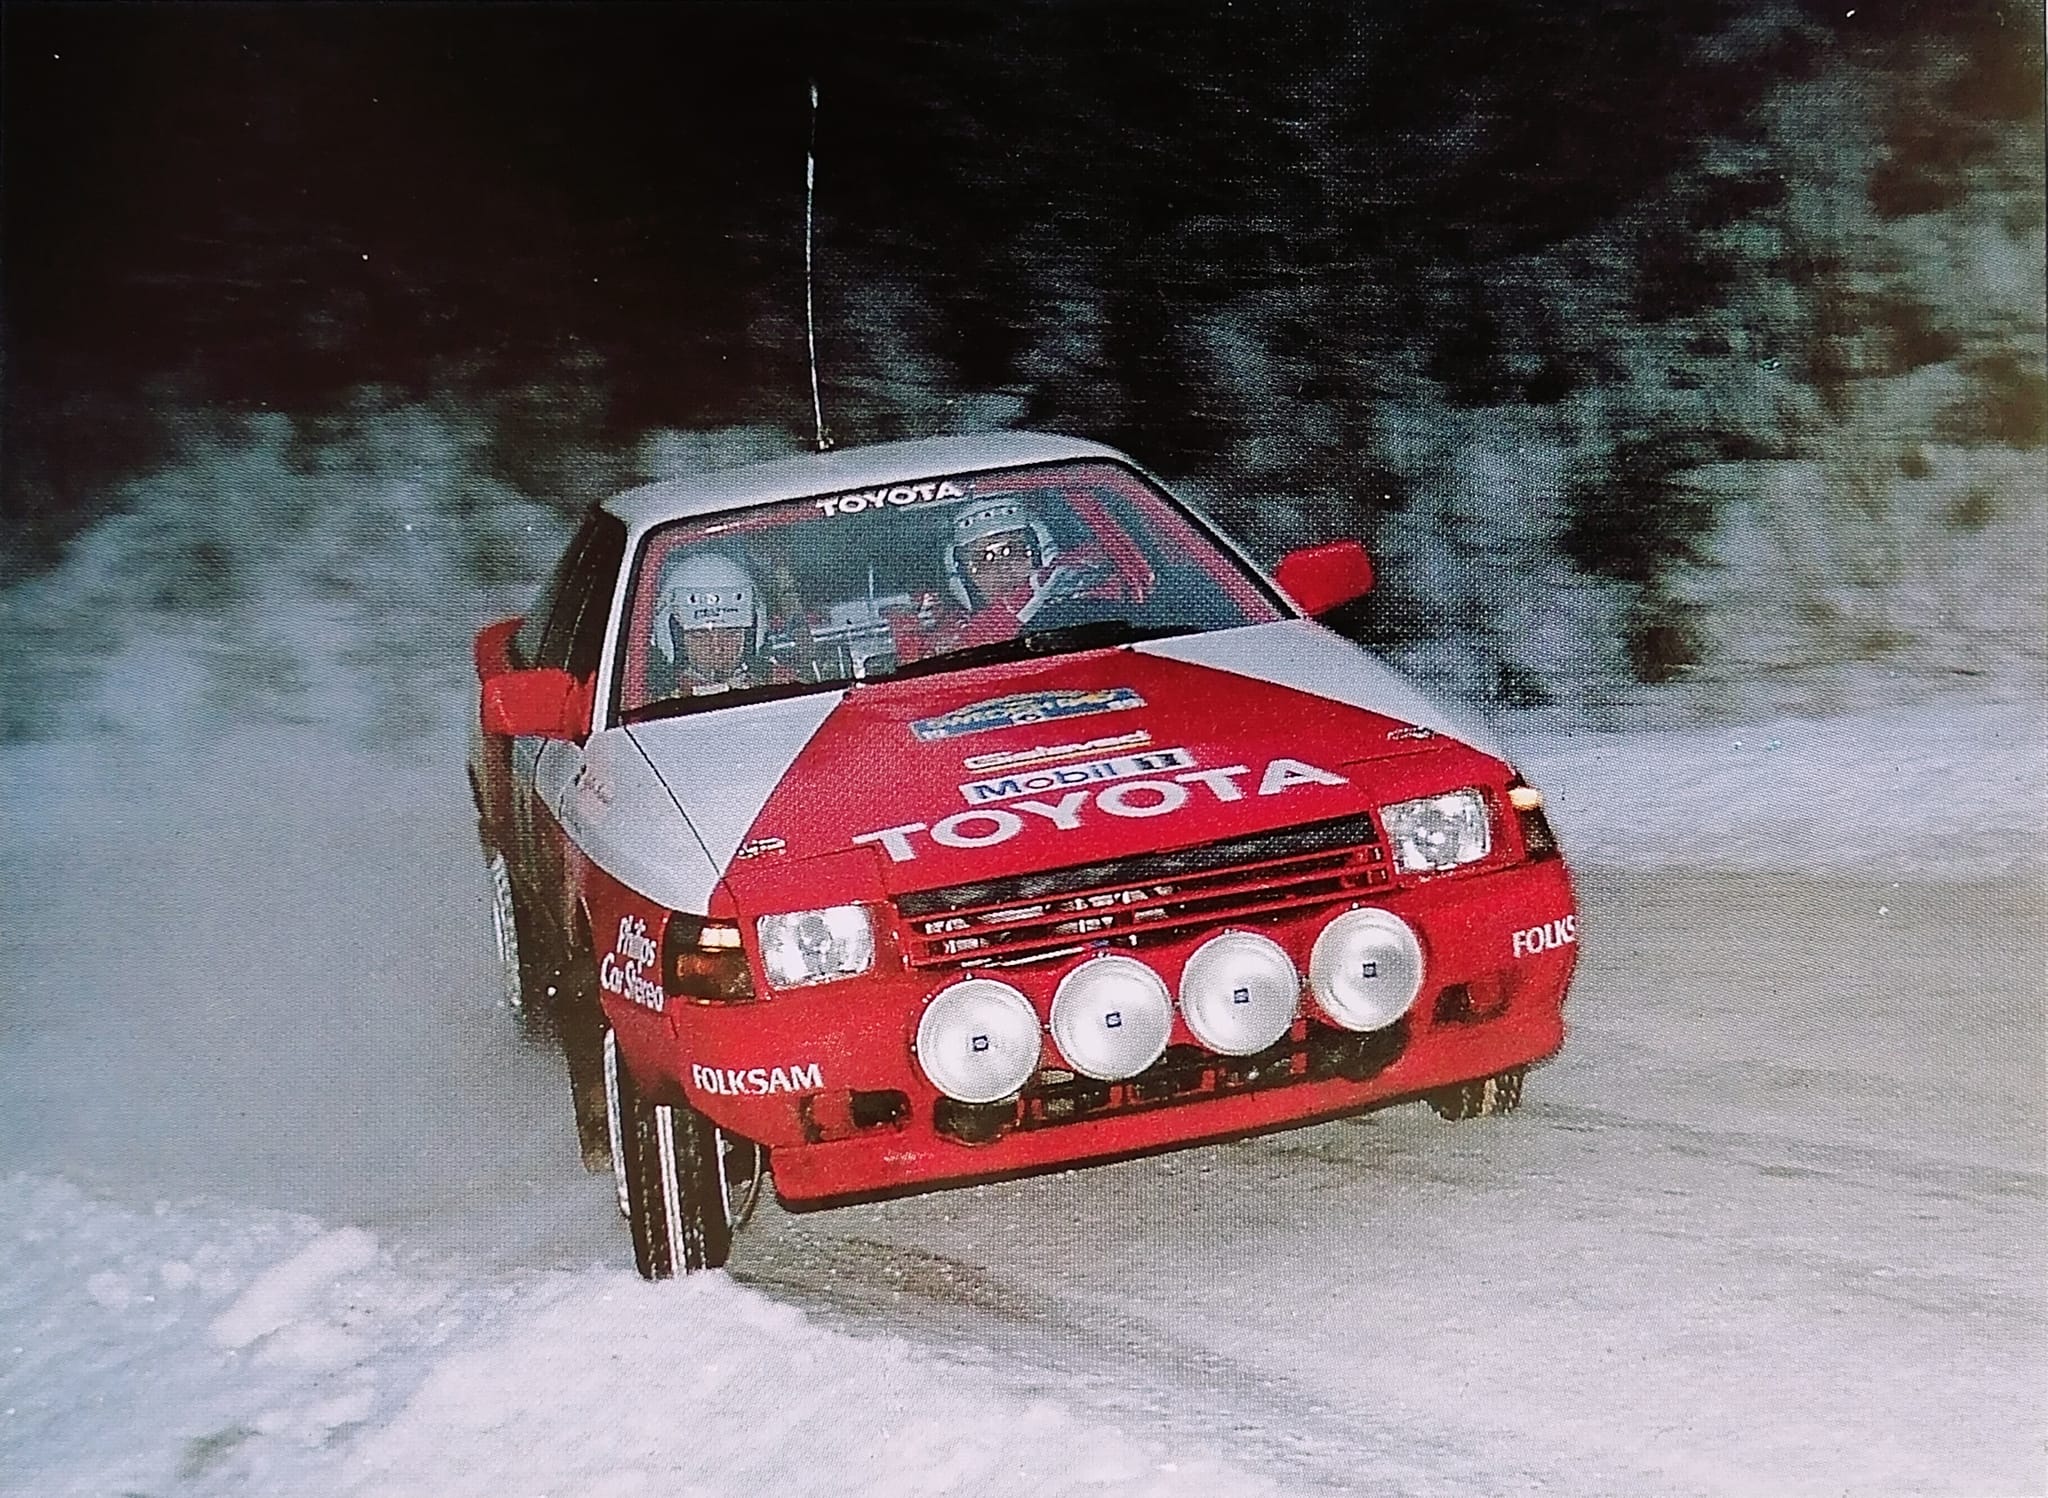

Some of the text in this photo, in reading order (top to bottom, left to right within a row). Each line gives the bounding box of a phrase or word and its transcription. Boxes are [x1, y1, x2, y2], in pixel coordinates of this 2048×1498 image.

[816, 481, 964, 517] TOYOTA
[972, 762, 1118, 799] Mobil
[853, 758, 1350, 863] TOYOTA
[601, 952, 664, 1012] Car Stereo
[692, 1063, 825, 1095] FOLKSAM
